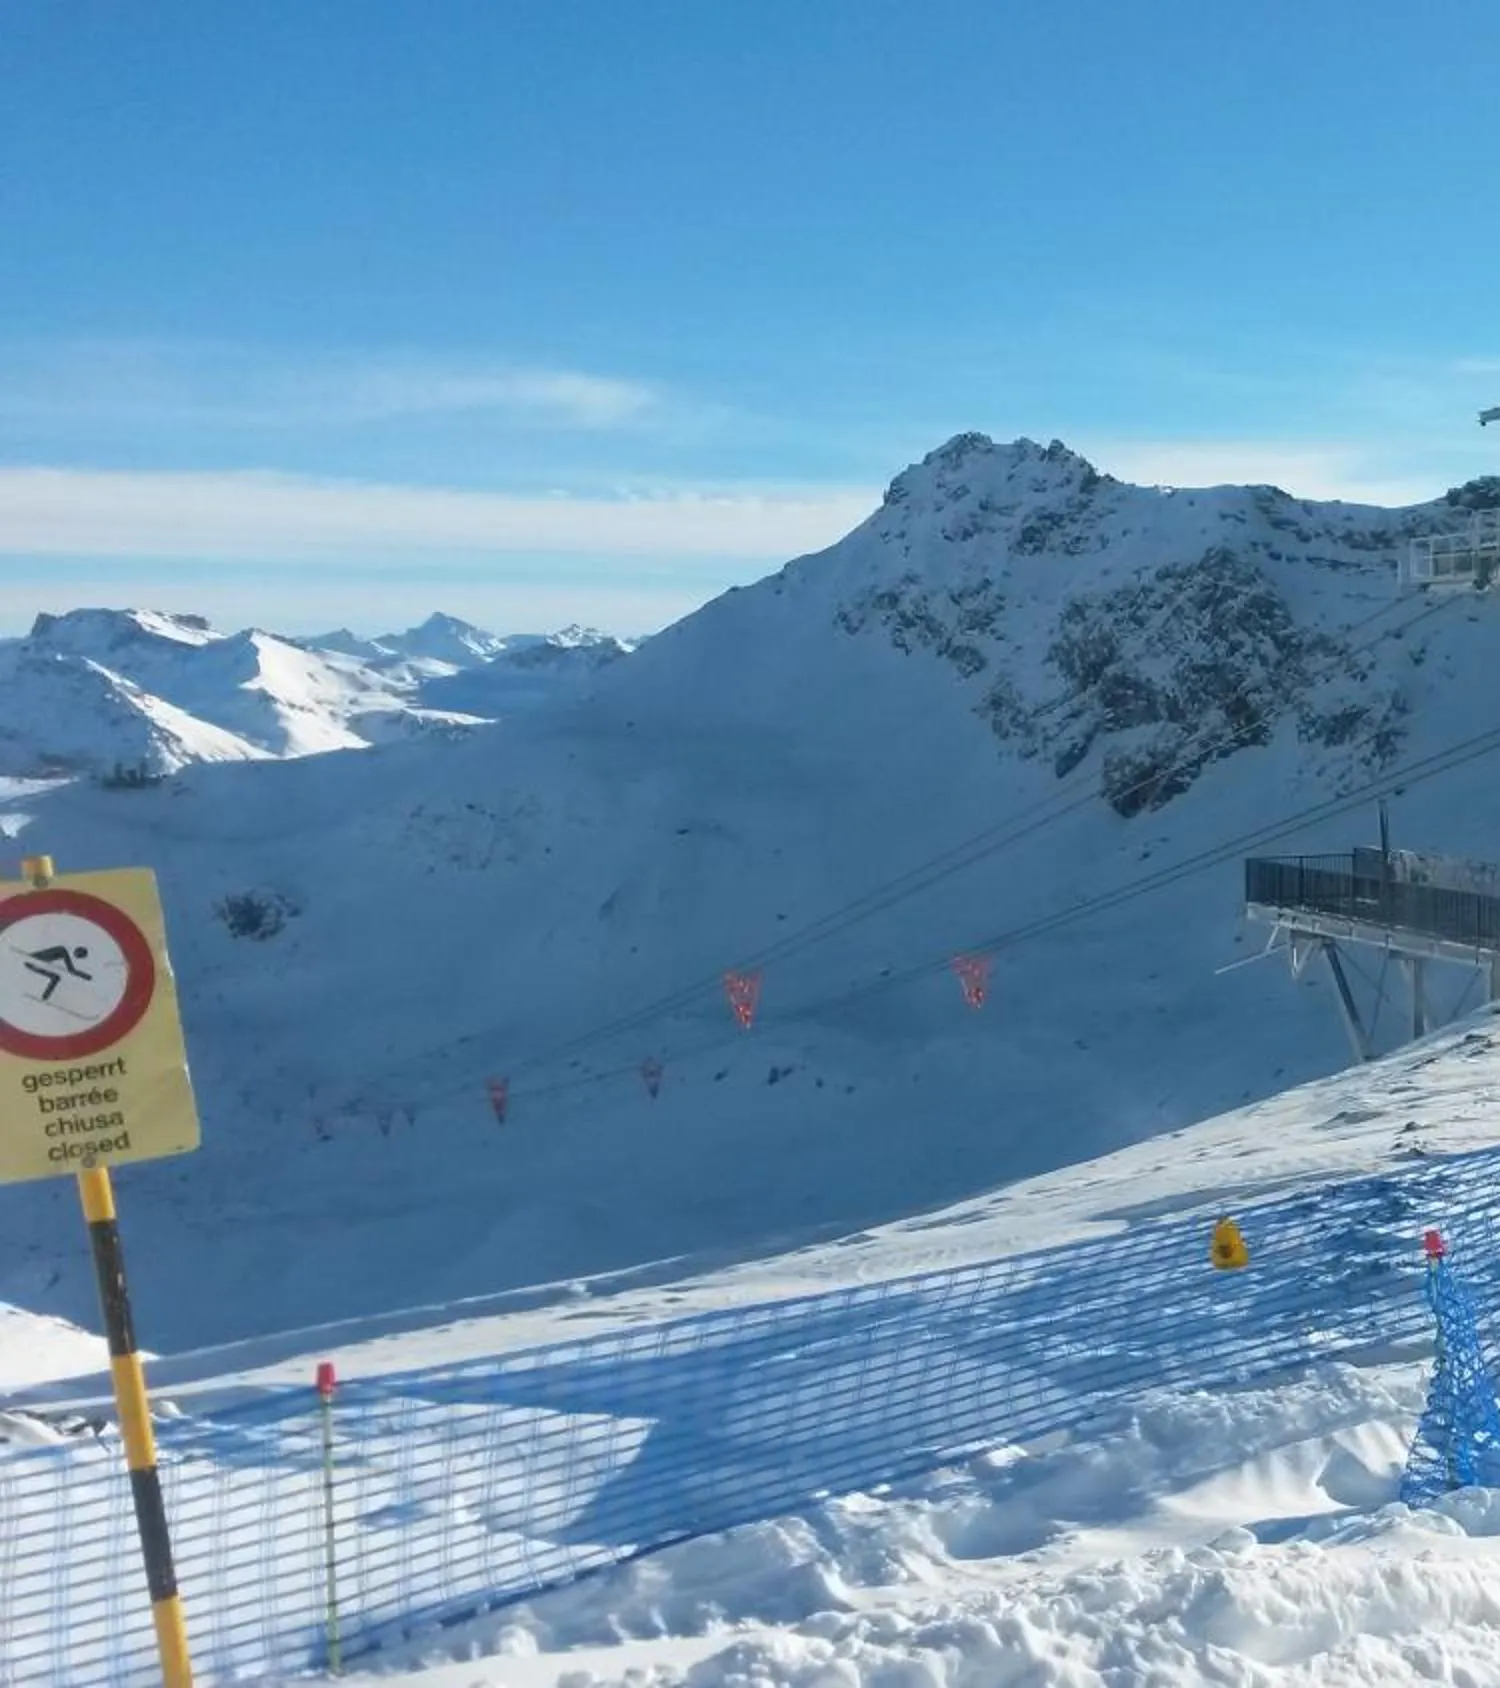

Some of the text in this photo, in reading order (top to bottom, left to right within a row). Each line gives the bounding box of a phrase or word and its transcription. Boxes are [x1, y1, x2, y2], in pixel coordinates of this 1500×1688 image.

[22, 1056, 128, 1093] gesperrt
[38, 1087, 119, 1113] barrée
[44, 1111, 124, 1137] chiusa
[47, 1131, 131, 1162] closed
